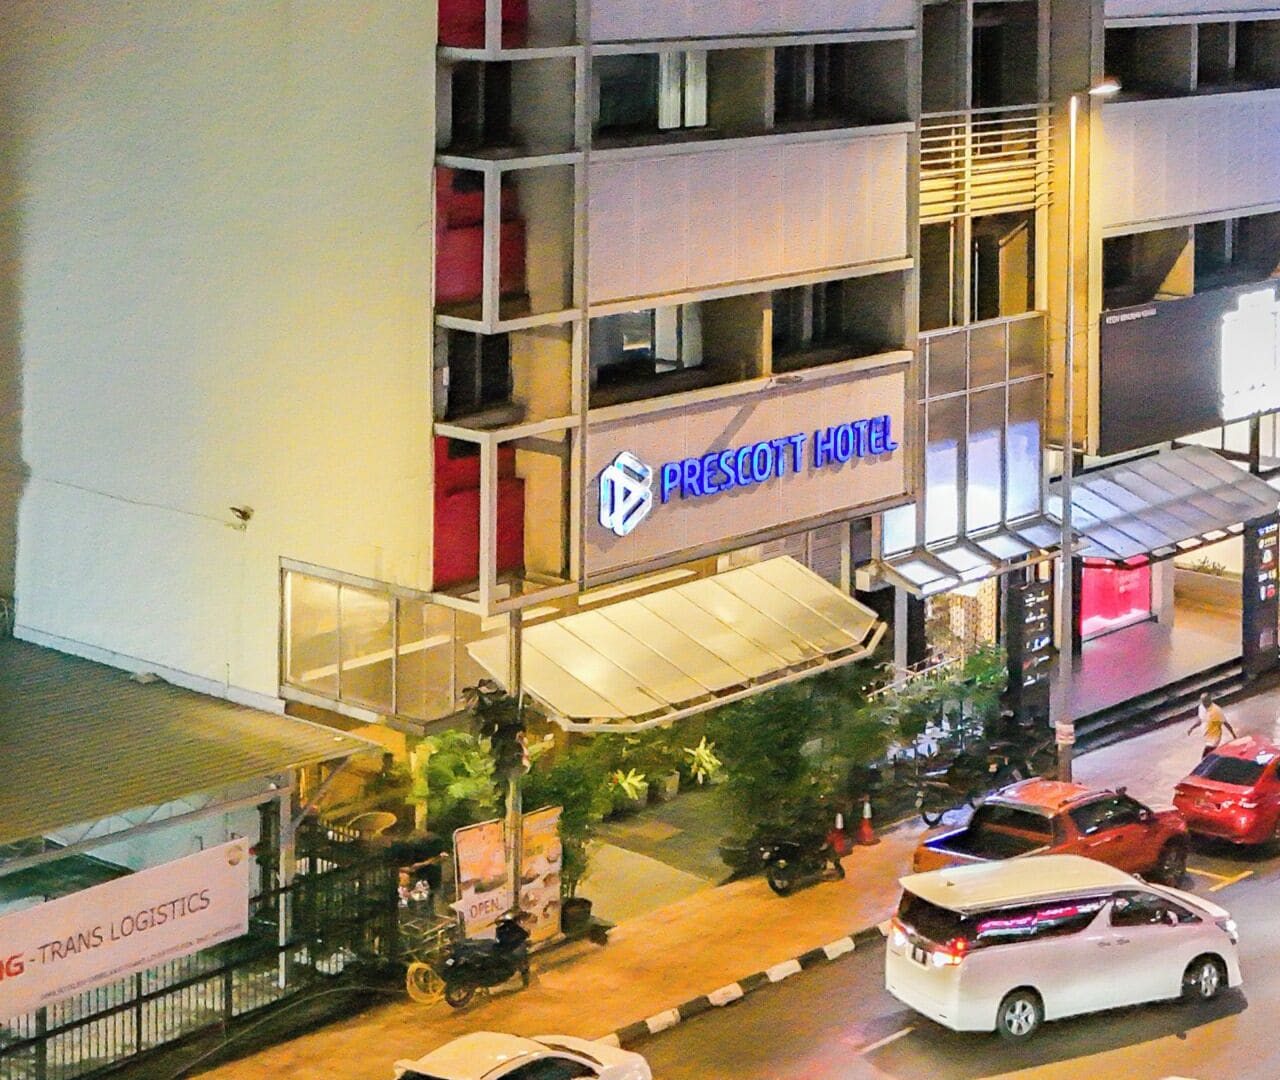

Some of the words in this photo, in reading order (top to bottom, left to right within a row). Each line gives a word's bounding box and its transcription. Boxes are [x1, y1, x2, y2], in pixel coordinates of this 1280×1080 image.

[661, 432, 807, 504] PRESCOTT
[814, 414, 898, 469] HOTEL
[111, 888, 212, 941] LOGISTICS
